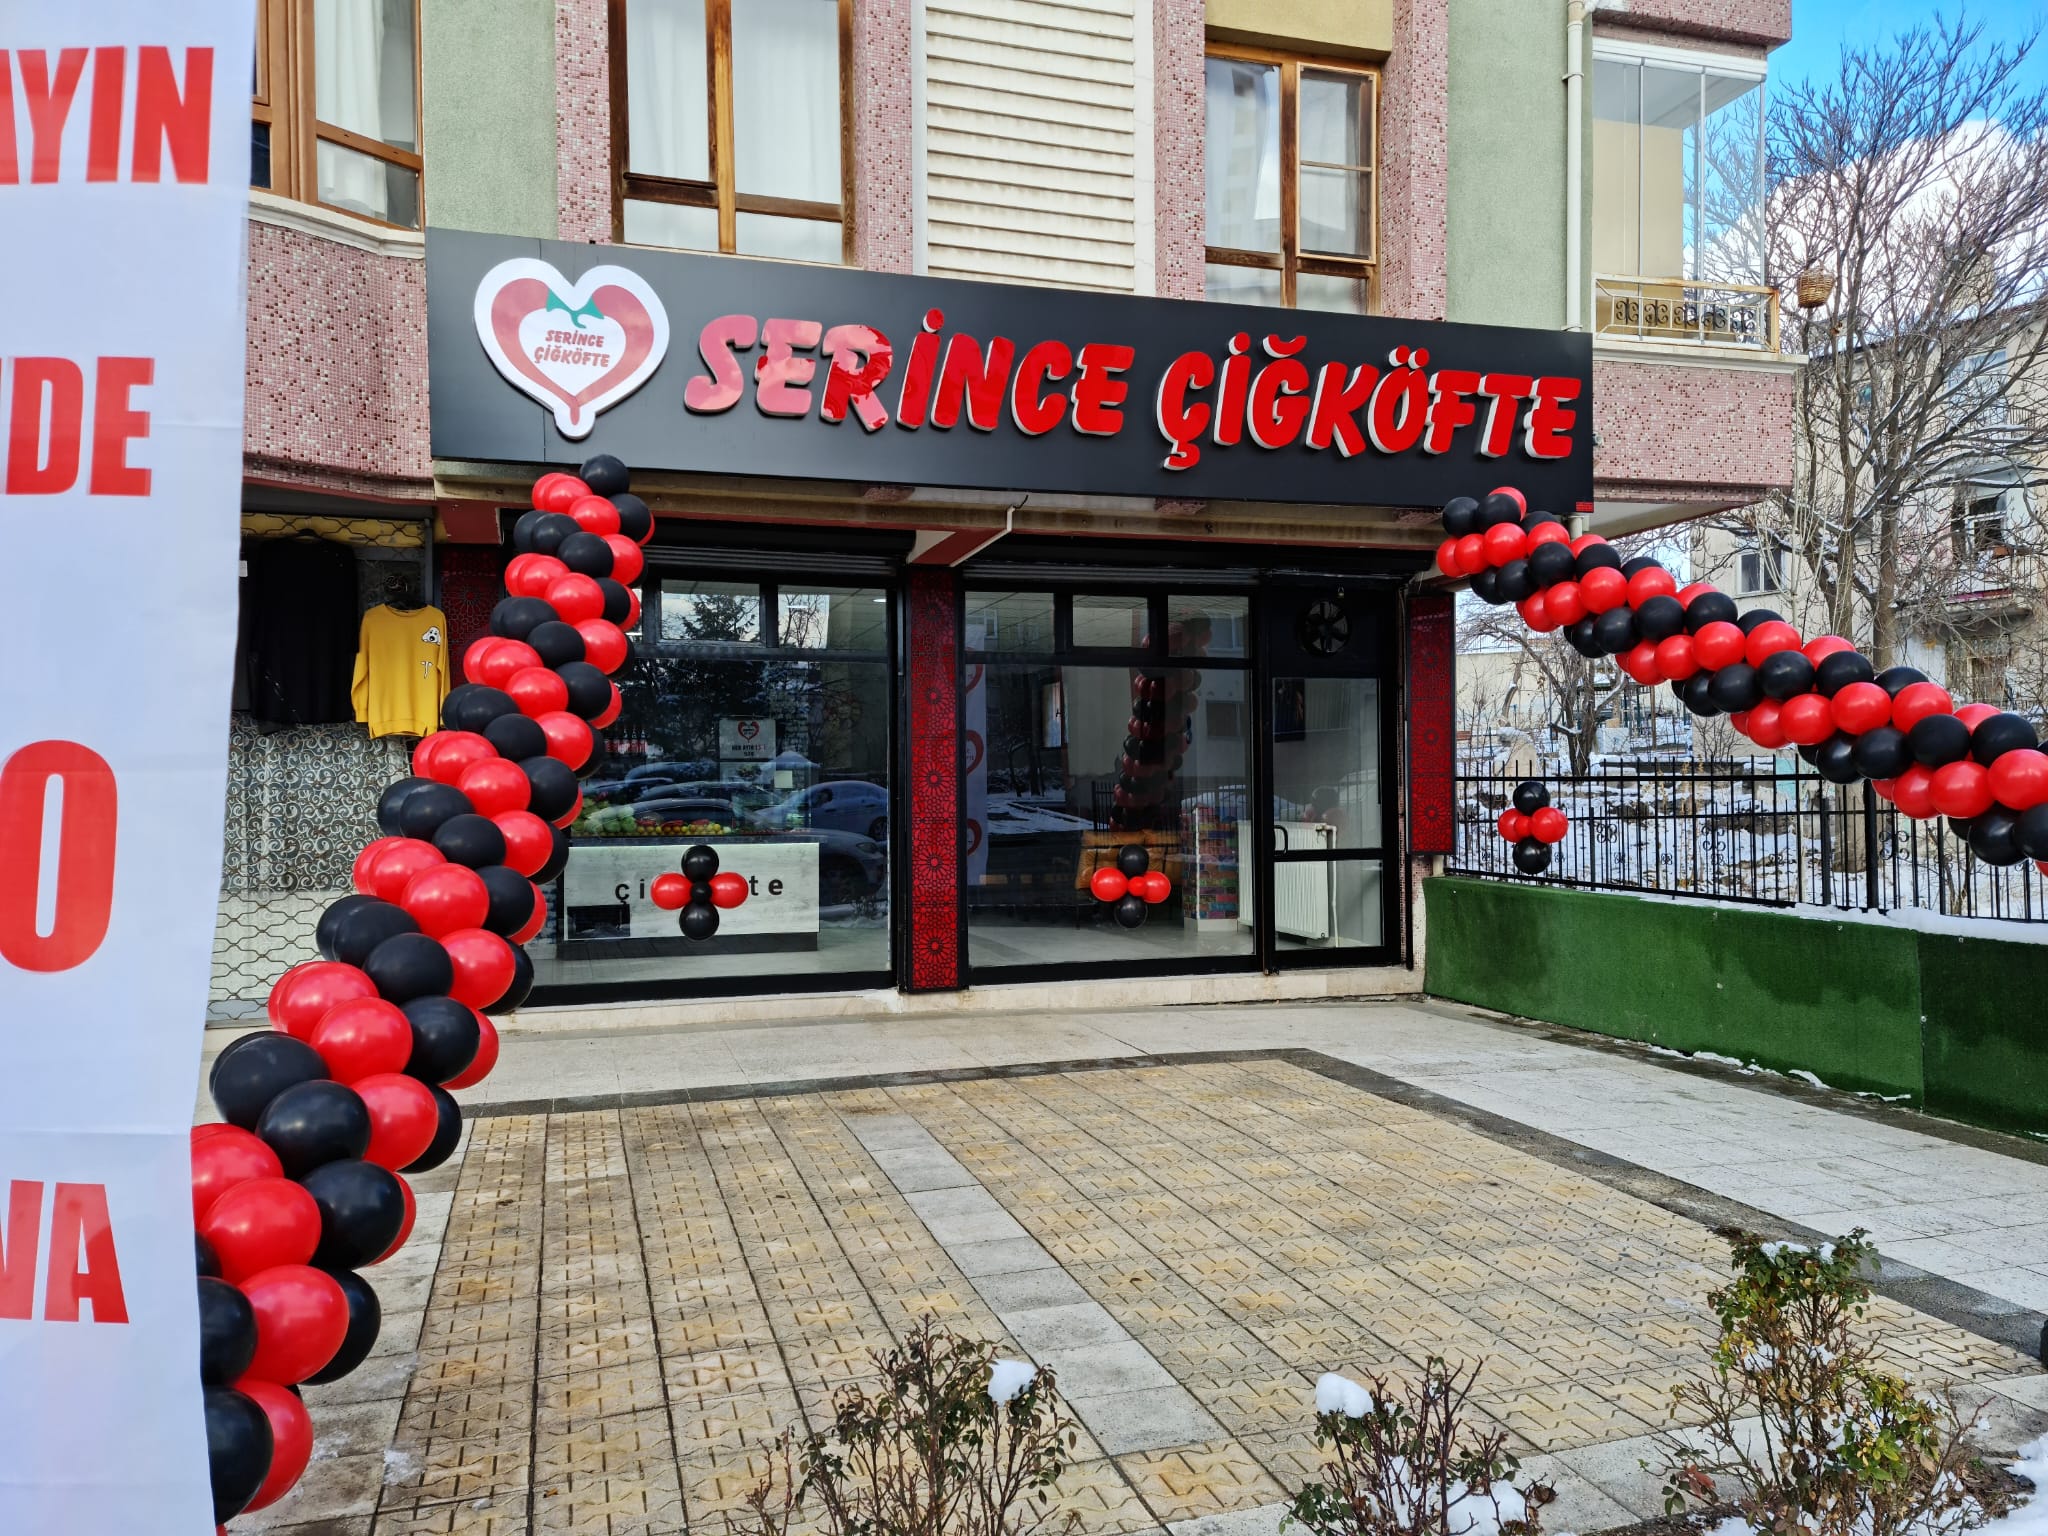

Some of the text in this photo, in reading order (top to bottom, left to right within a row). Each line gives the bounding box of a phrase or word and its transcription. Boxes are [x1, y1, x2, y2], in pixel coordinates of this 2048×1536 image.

[0, 45, 214, 185] YIN
[534, 344, 610, 368] ÇİĞKÖFTE
[545, 330, 605, 348] SERİNCE
[685, 307, 1582, 471] SERİNCE ÇİĞKÖFTE
[0, 356, 155, 497] DE
